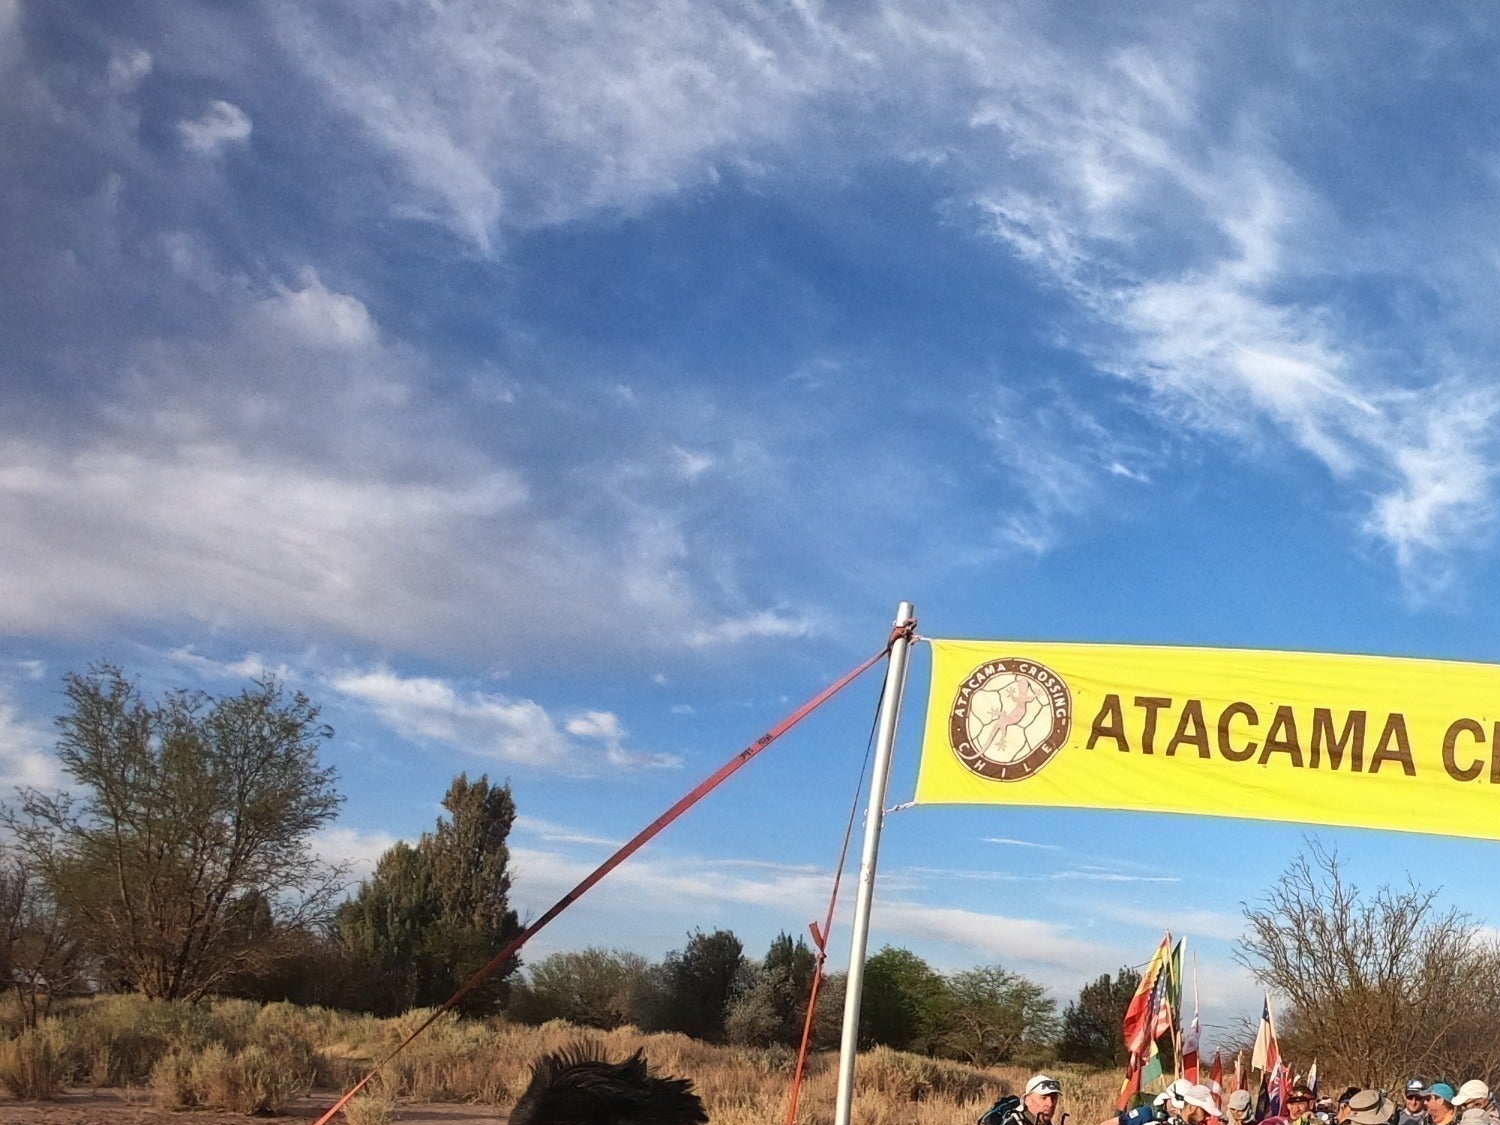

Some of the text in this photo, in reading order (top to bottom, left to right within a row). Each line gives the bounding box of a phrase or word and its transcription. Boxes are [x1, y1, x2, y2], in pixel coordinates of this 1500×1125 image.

[955, 663, 1067, 719] ATACAMA CROSSING
[958, 742, 1053, 778] CHILE
[1085, 693, 1417, 777] ATACAMA
